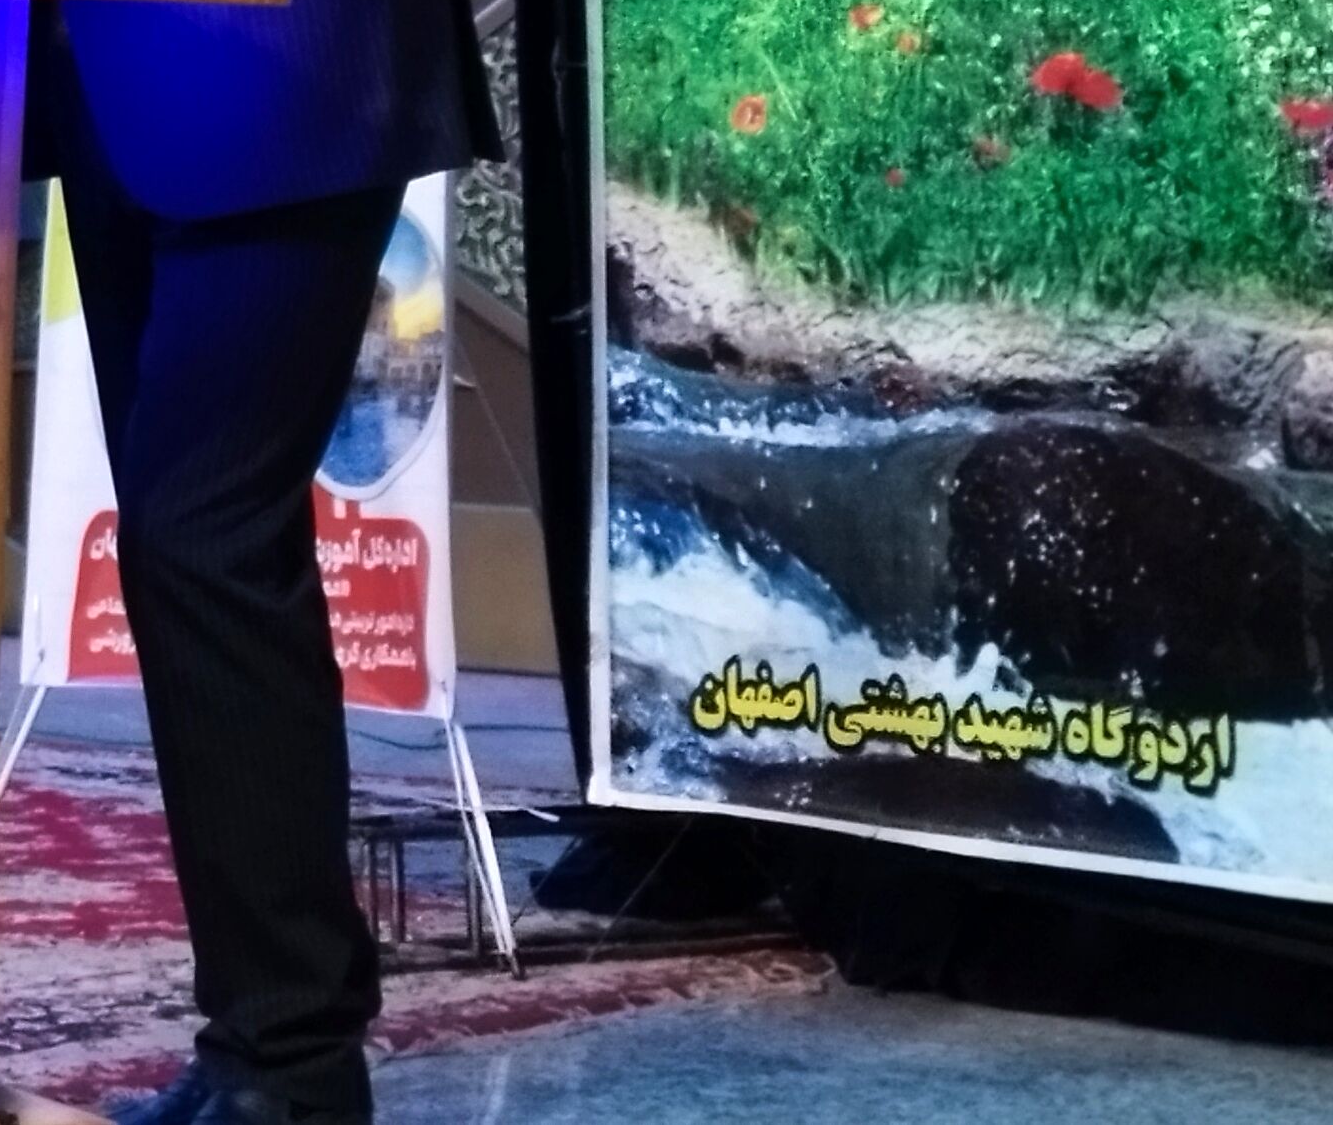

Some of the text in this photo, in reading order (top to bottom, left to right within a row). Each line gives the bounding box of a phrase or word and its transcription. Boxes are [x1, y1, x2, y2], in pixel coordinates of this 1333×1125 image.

[690, 654, 1236, 795] اردوگاه شهید بهشتی اصفهان
